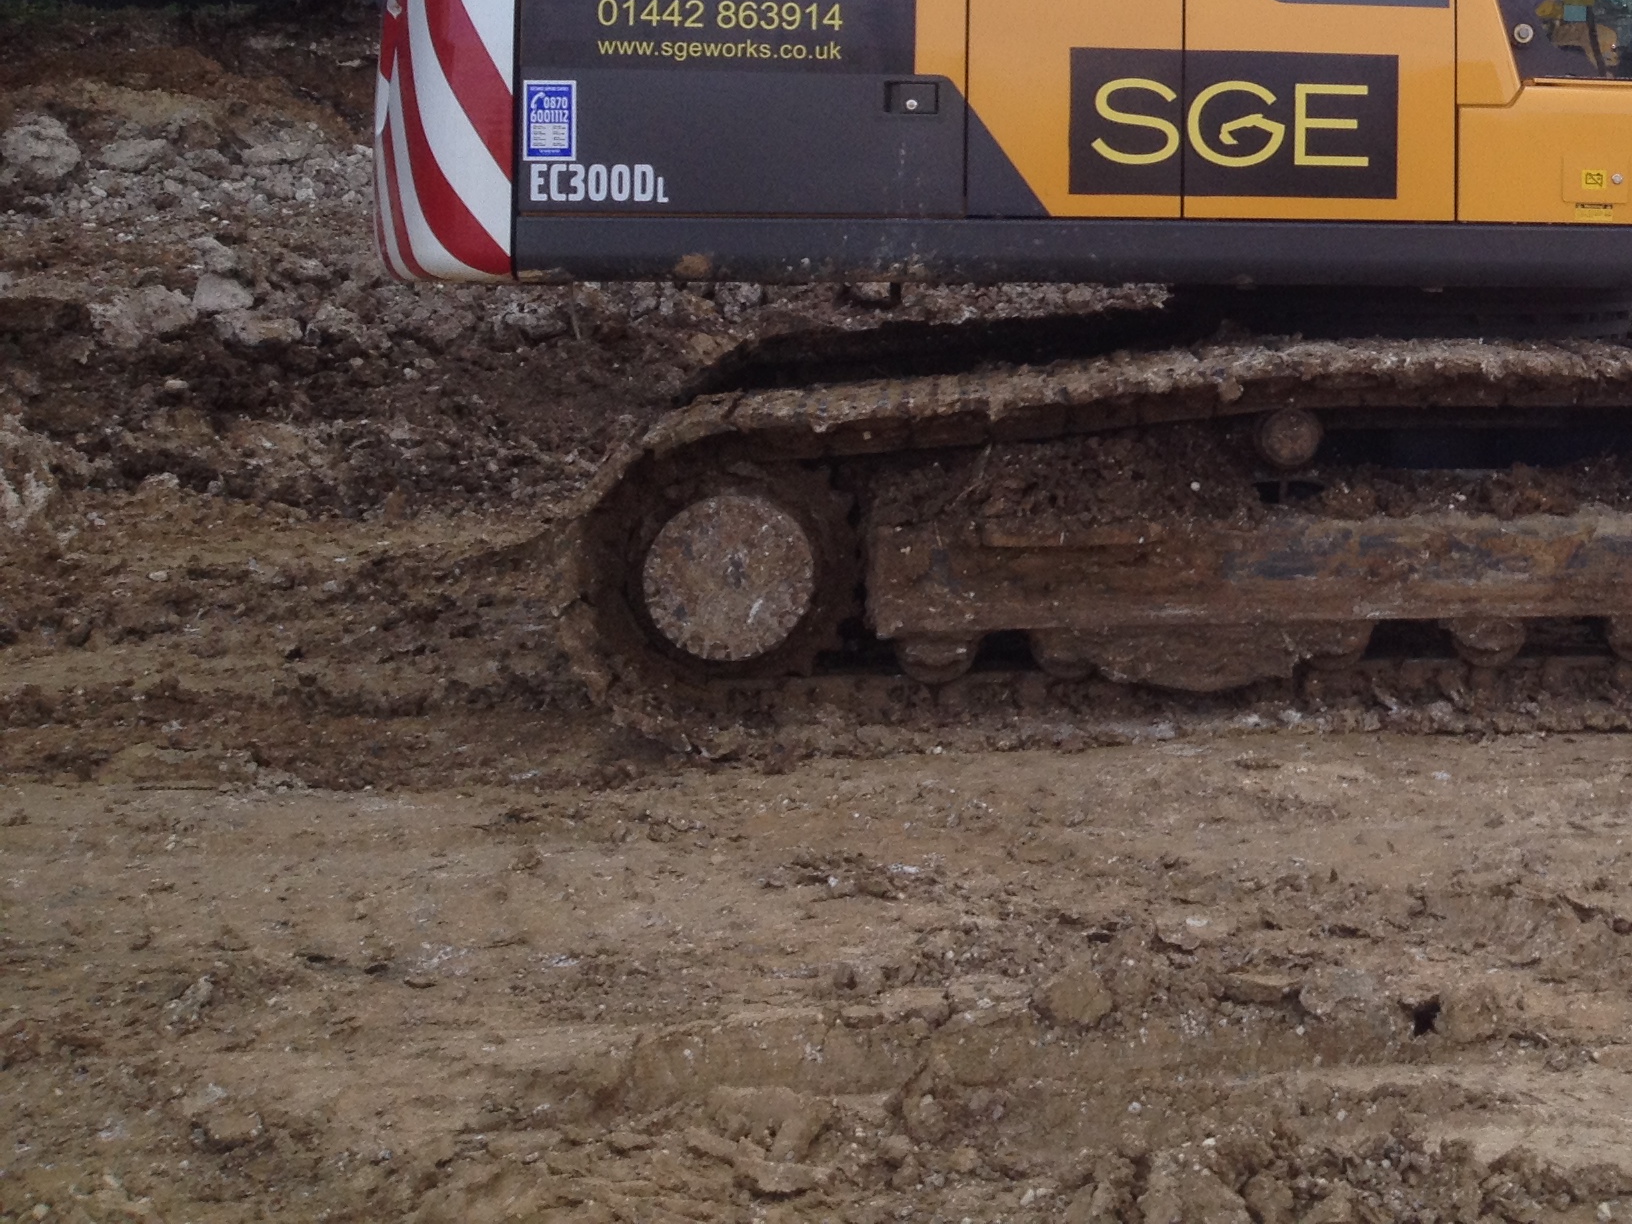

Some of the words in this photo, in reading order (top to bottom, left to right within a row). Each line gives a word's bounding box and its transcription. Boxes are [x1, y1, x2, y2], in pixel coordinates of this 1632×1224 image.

[716, 0, 843, 31] 863914
[598, 39, 842, 61] www.sgeworks.co.uk
[543, 96, 568, 109] 0870
[530, 109, 569, 123] 6001112
[1091, 78, 1369, 167] SGE
[530, 164, 669, 203] EC300DL
